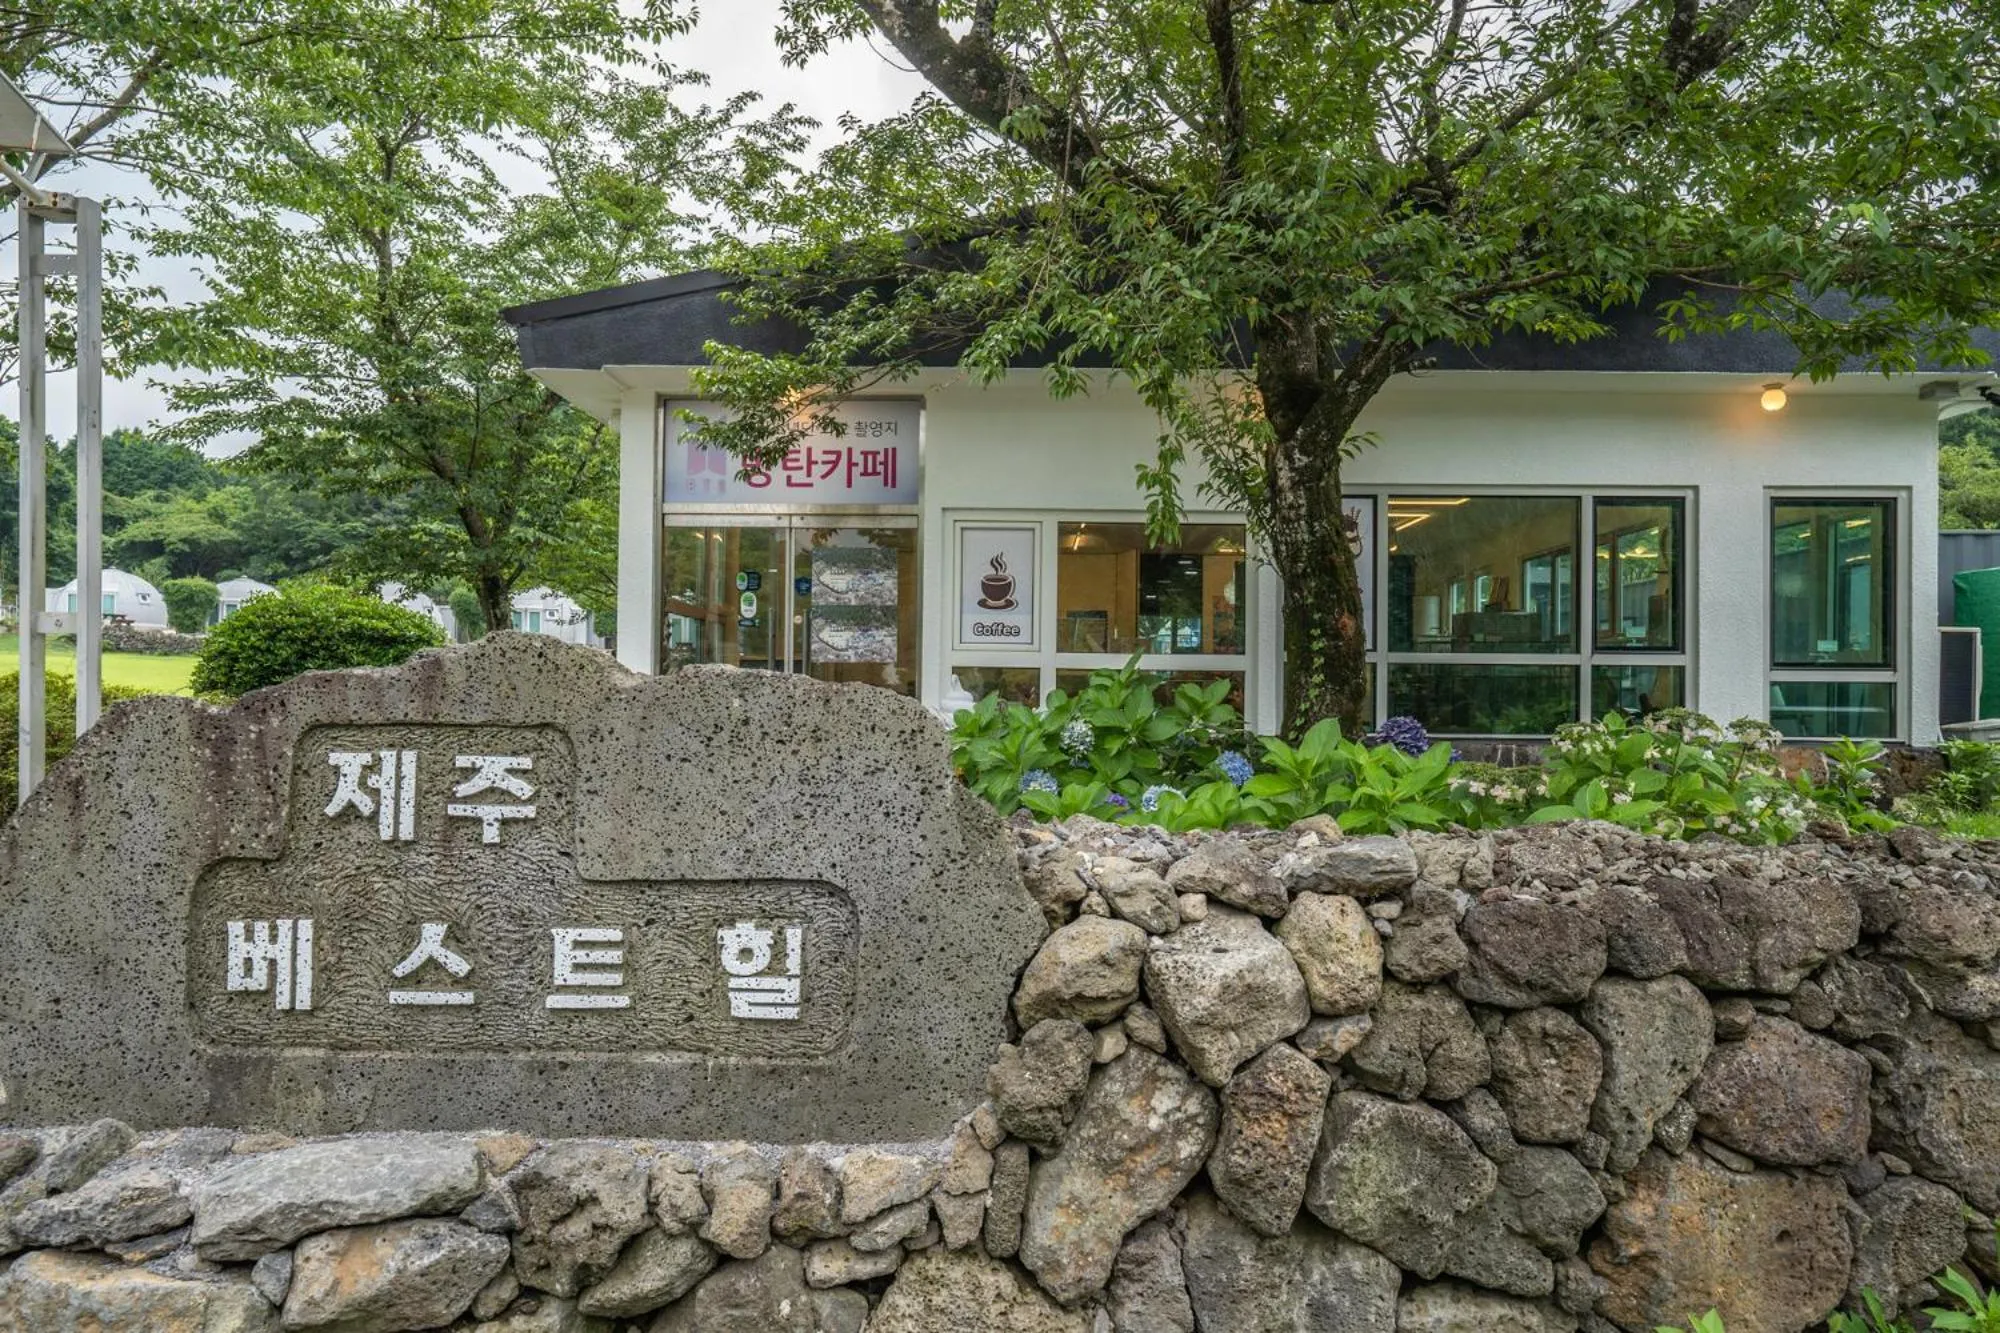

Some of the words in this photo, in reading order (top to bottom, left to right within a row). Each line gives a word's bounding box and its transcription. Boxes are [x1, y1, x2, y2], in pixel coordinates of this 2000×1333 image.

[853, 420, 898, 438] 촬영지
[972, 622, 1021, 637] Coffee
[324, 751, 537, 844] 제주
[226, 918, 802, 1020] 베스트힐
